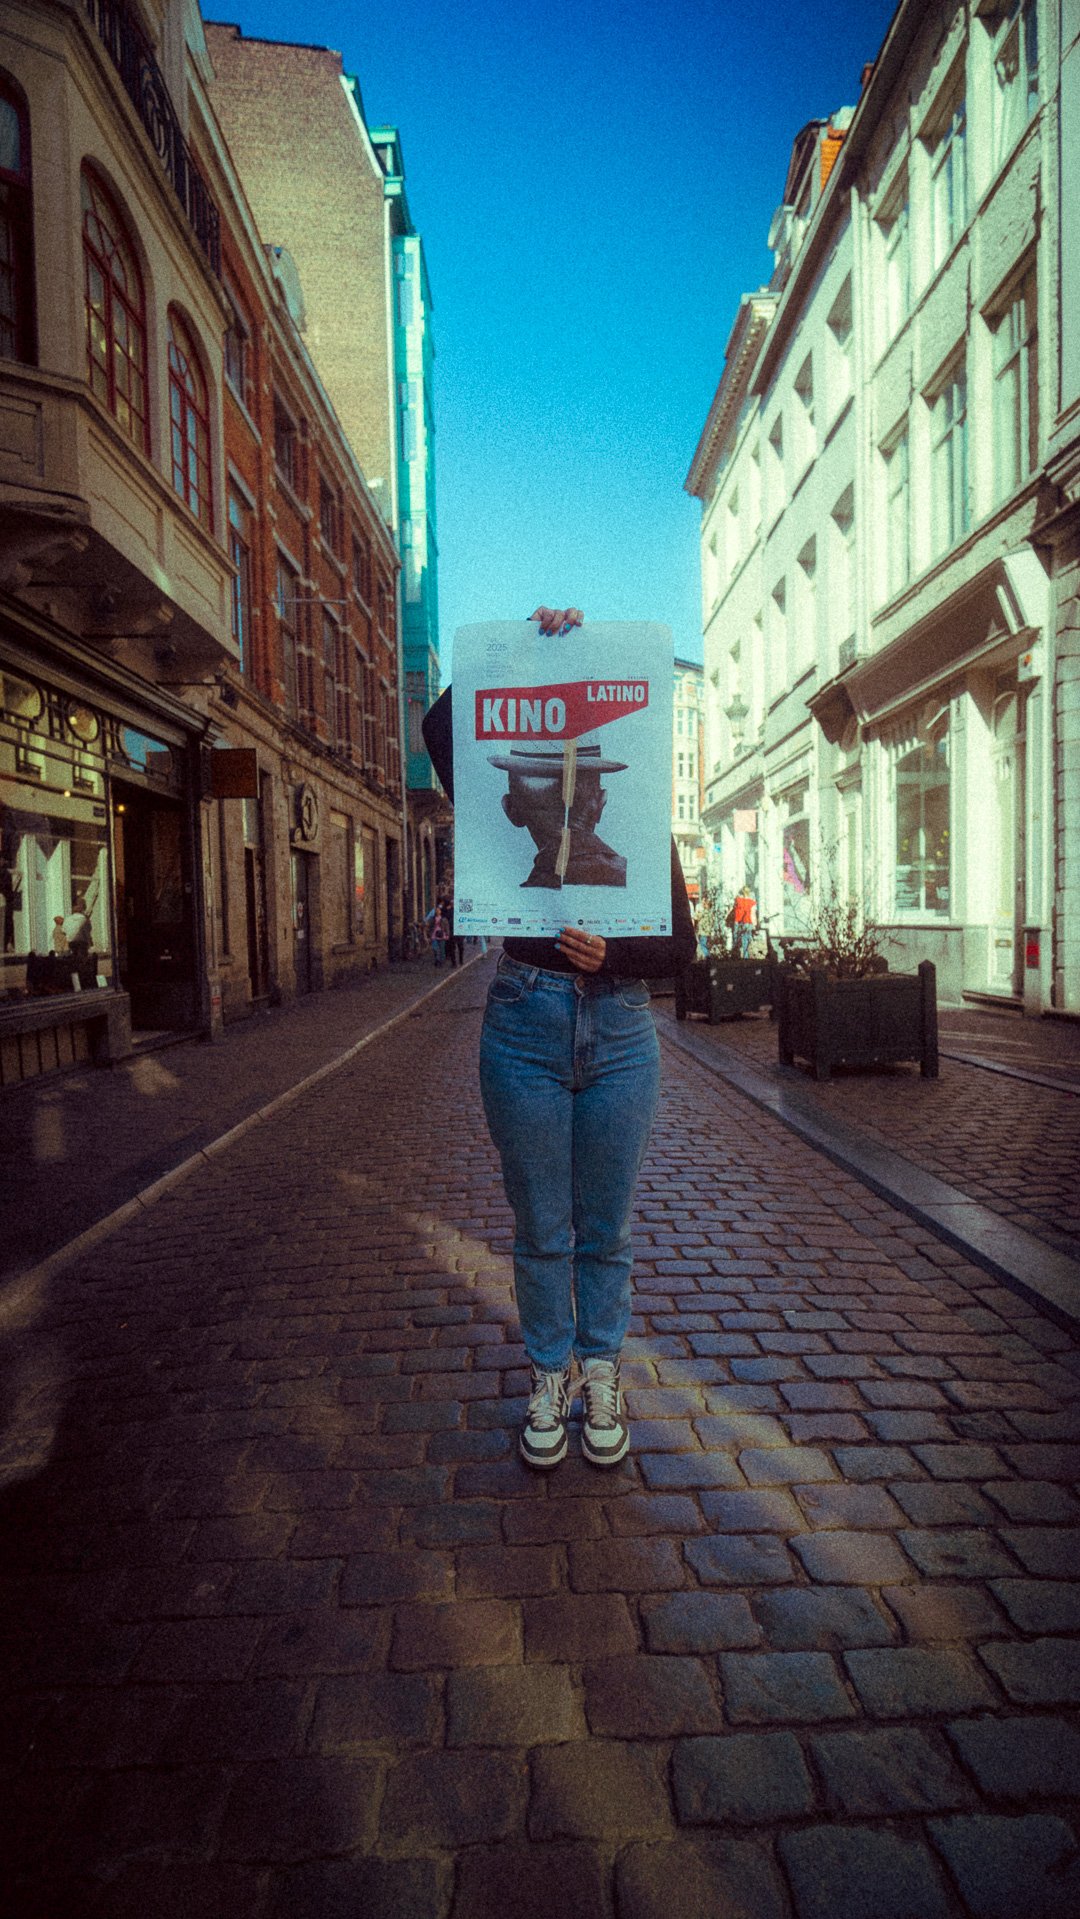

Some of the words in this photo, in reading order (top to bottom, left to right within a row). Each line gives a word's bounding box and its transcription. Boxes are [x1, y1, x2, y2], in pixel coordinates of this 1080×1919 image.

[486, 643, 508, 652] 2025
[482, 697, 566, 733] KINO
[587, 684, 645, 703] LATINO
